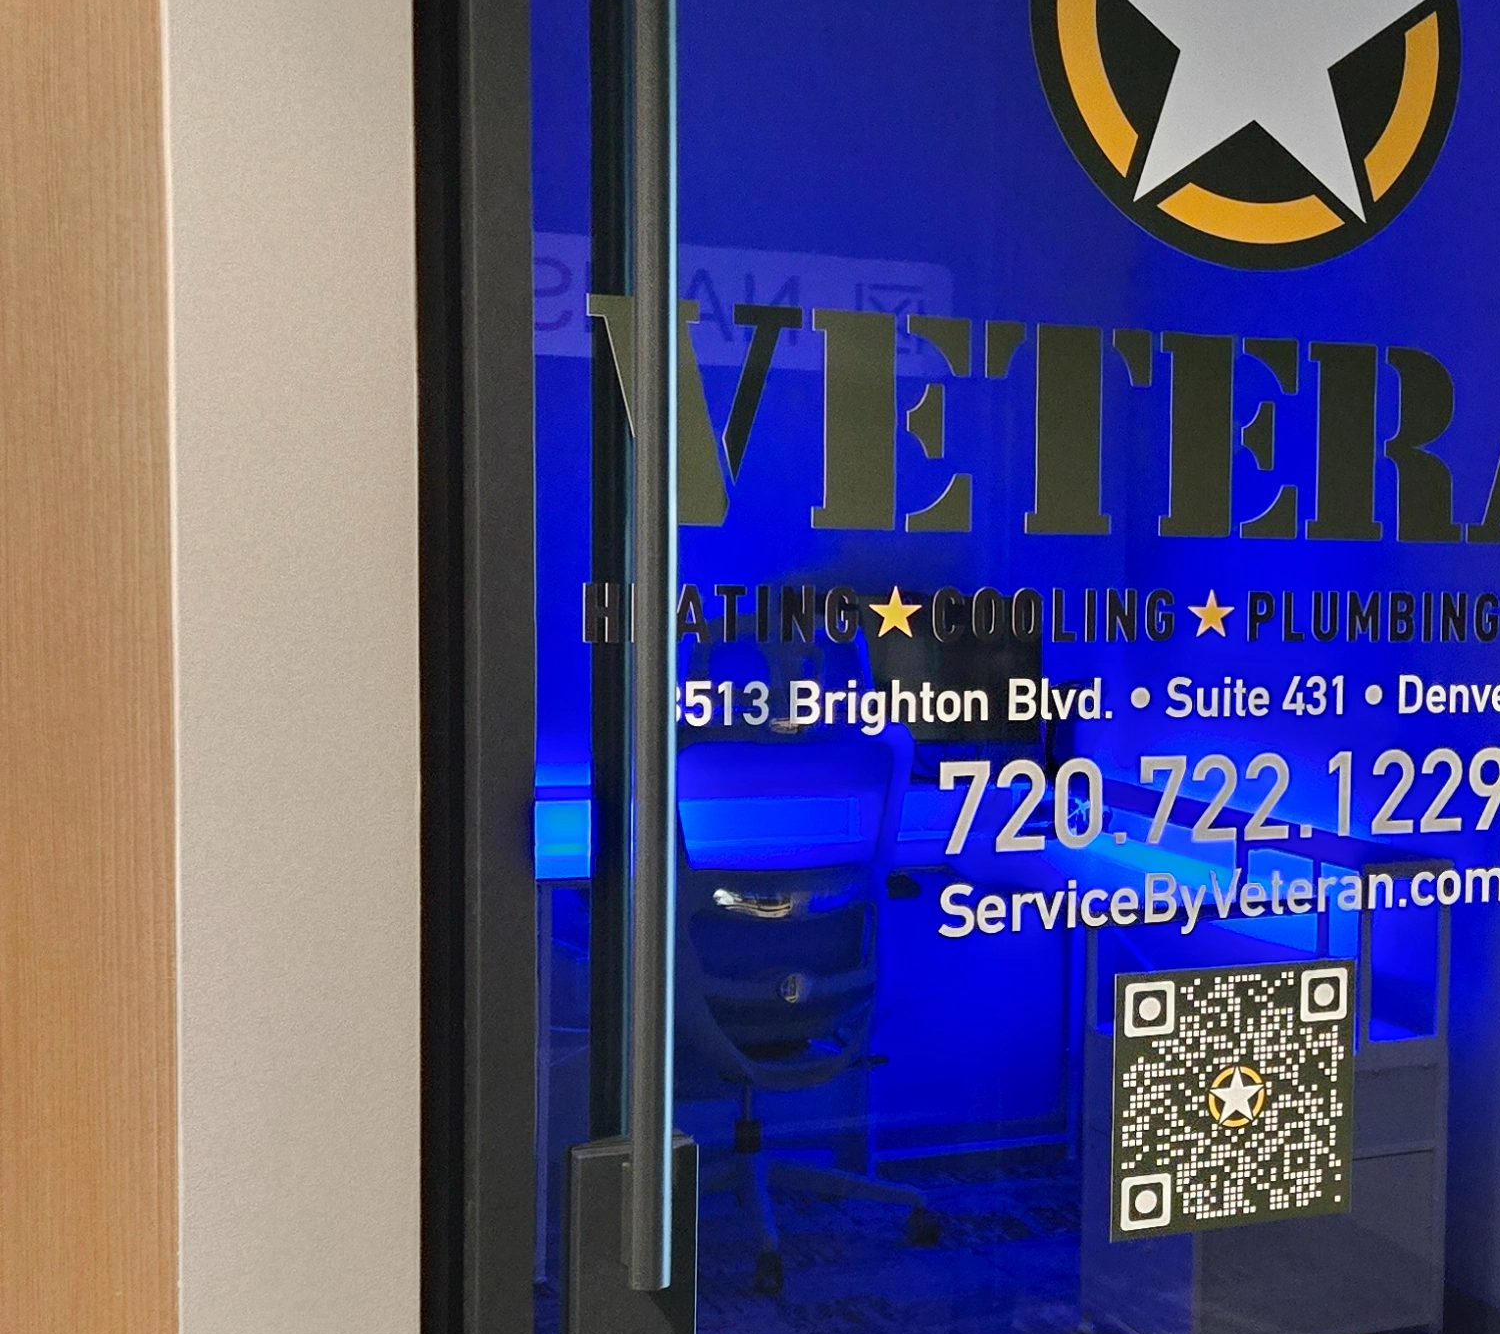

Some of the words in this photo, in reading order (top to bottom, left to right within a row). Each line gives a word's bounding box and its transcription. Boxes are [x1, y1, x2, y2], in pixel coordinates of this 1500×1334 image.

[582, 583, 860, 643] HATING
[931, 587, 1176, 644] COOLING
[1246, 591, 1500, 643] PLUMBING
[672, 681, 771, 726] 513
[788, 680, 990, 735] Brighton
[1007, 678, 1114, 722] Blvd.
[1164, 677, 1270, 718] Suite
[1281, 676, 1345, 716] 431
